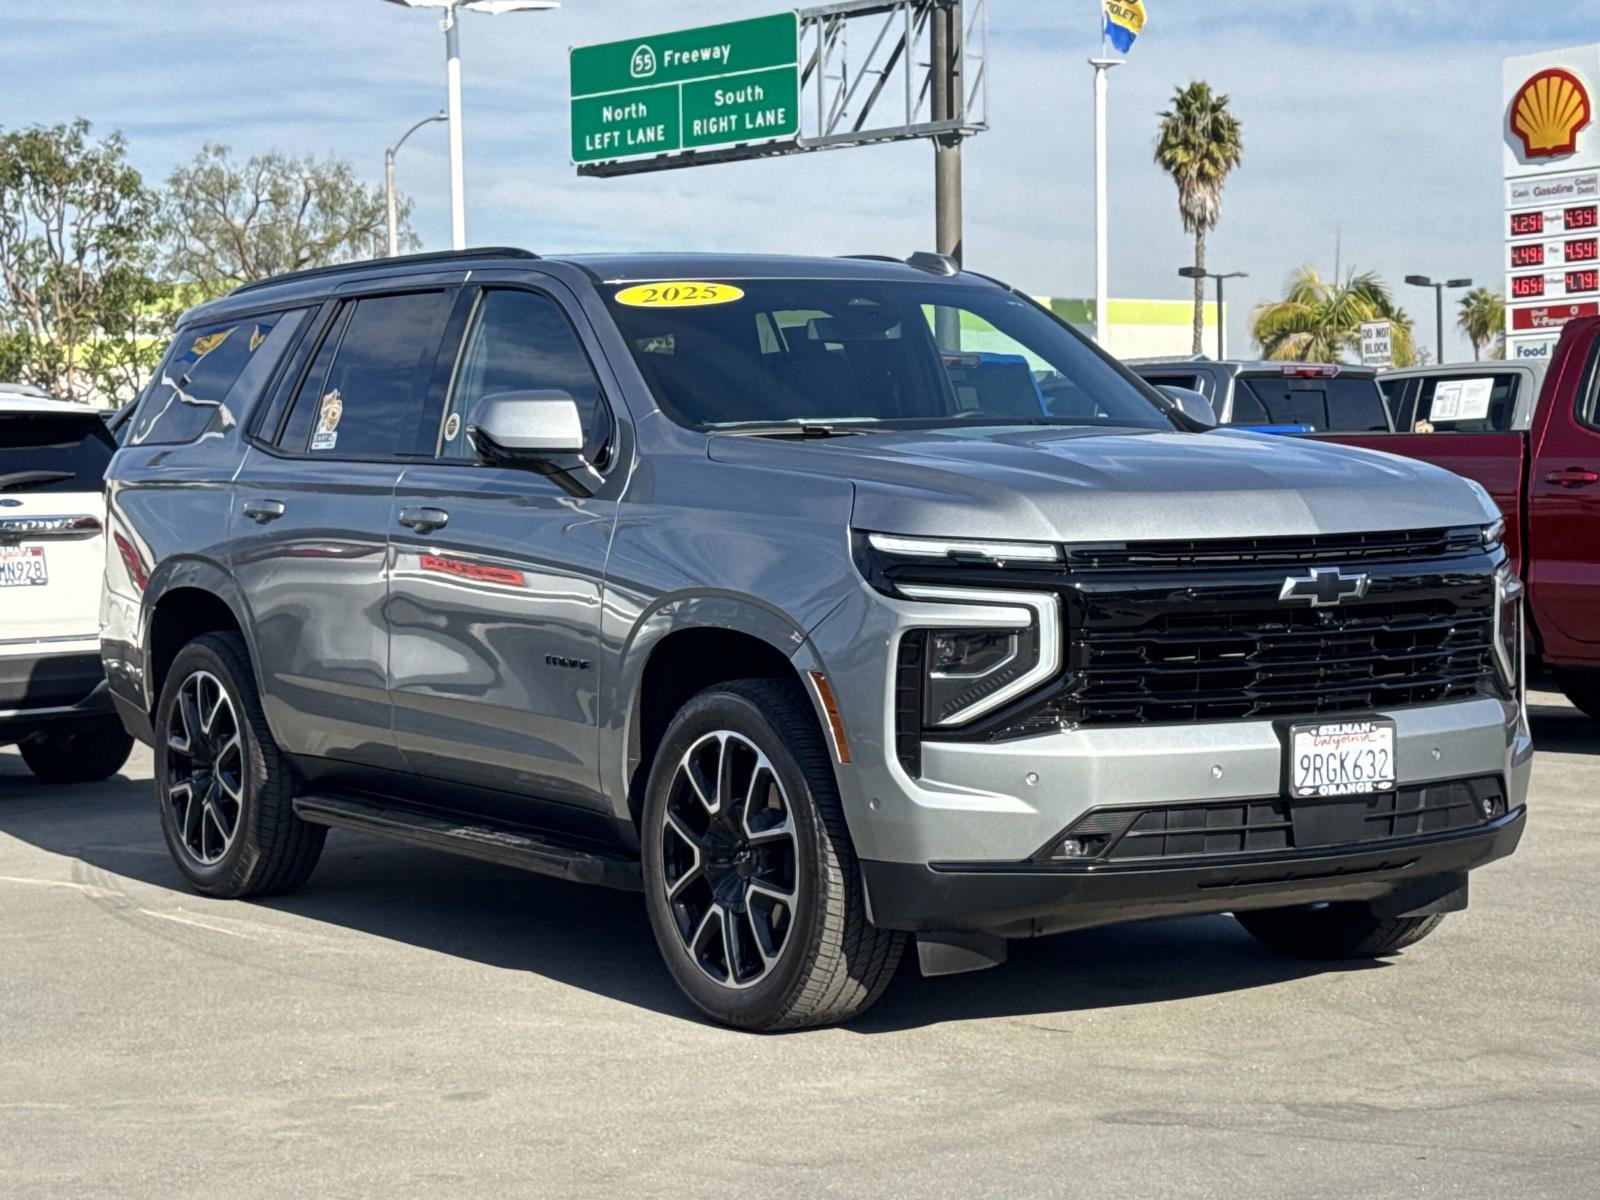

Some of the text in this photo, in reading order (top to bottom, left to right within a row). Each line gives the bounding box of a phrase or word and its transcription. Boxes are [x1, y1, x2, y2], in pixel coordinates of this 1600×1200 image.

[634, 44, 731, 72] 55 Freeway
[714, 85, 764, 107] South
[602, 102, 648, 123] North
[693, 108, 786, 136] RIGHT LANE
[585, 124, 665, 151] LEFT LANE
[1533, 184, 1574, 197] Gasoline
[642, 285, 719, 303] 2025
[1531, 316, 1575, 327] V-Pow
[1362, 327, 1390, 339] DO NOT
[1364, 342, 1389, 354] BLOCK
[1516, 342, 1548, 358] Food
[1318, 722, 1371, 736] SELMAN
[1300, 748, 1389, 787] 9RGK632
[1319, 781, 1373, 796] ORANGE
